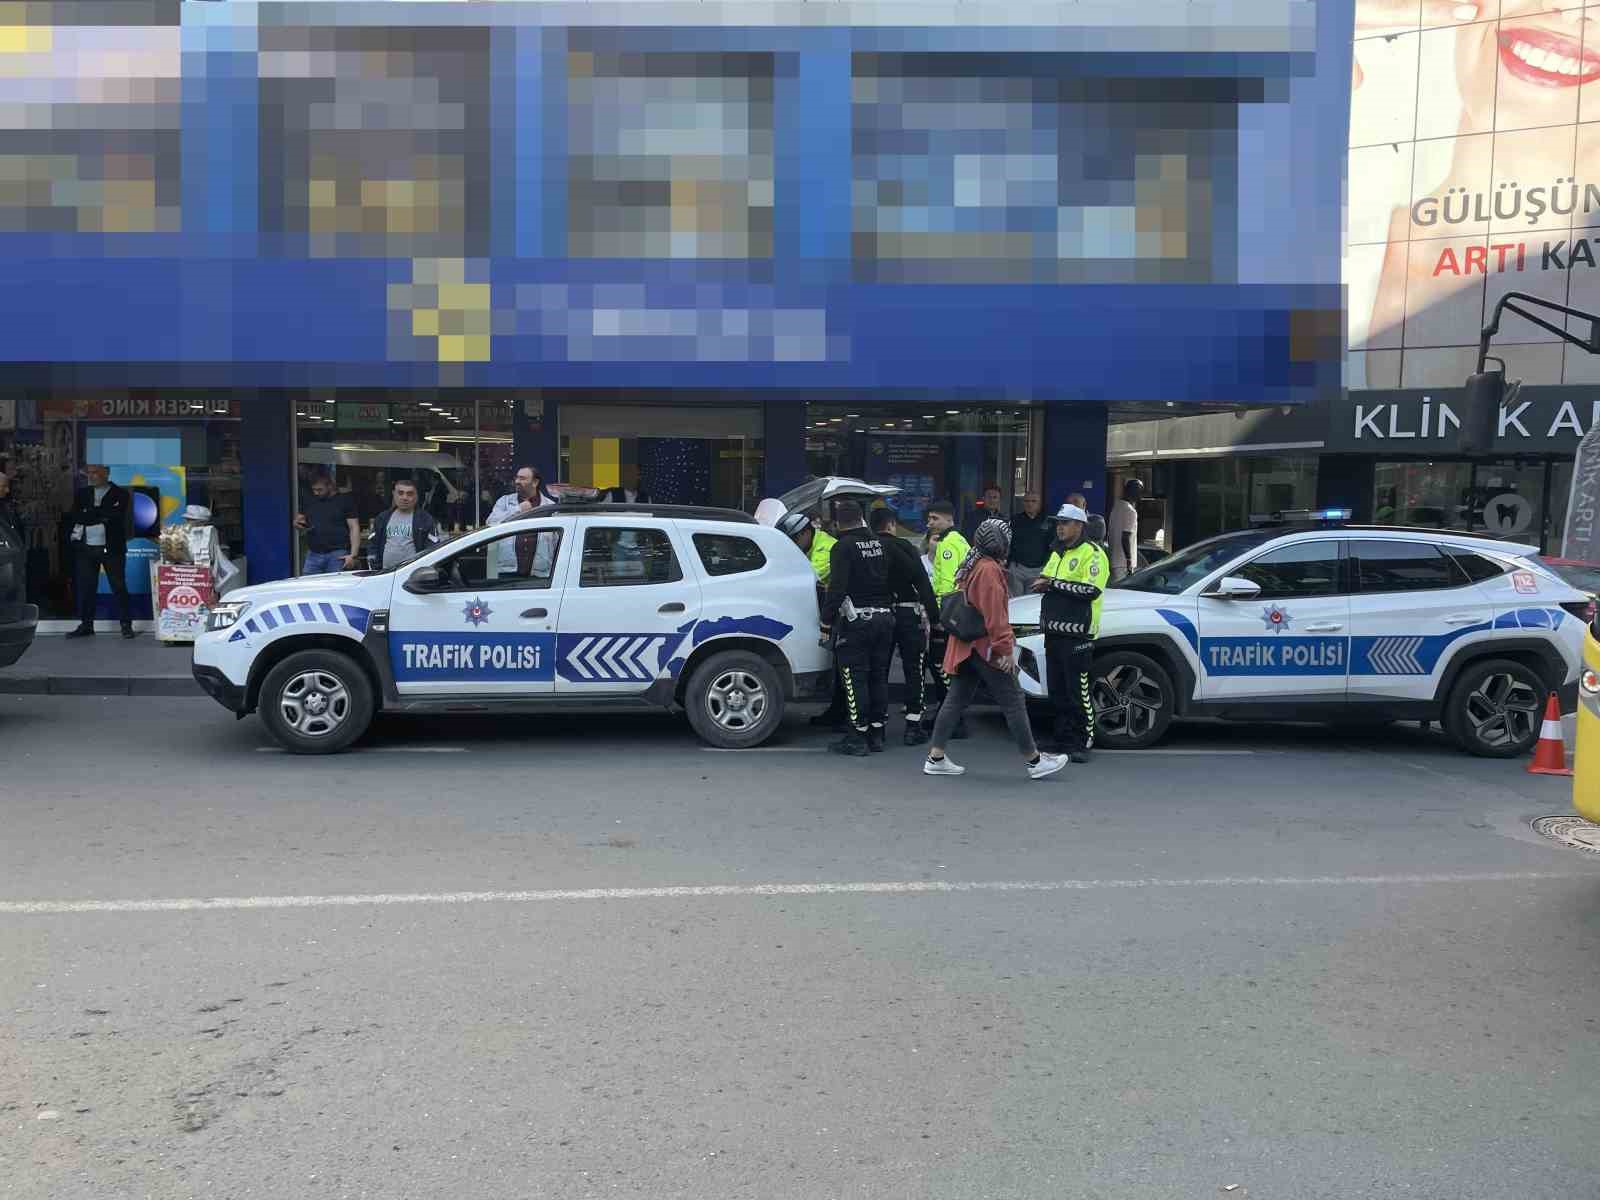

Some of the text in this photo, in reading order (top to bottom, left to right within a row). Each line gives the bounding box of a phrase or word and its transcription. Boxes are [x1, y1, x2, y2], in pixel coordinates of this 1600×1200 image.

[1433, 238, 1600, 277] ARTI KA
[168, 595, 200, 606] 400
[1209, 641, 1343, 666] TRAFİK POLİSİ
